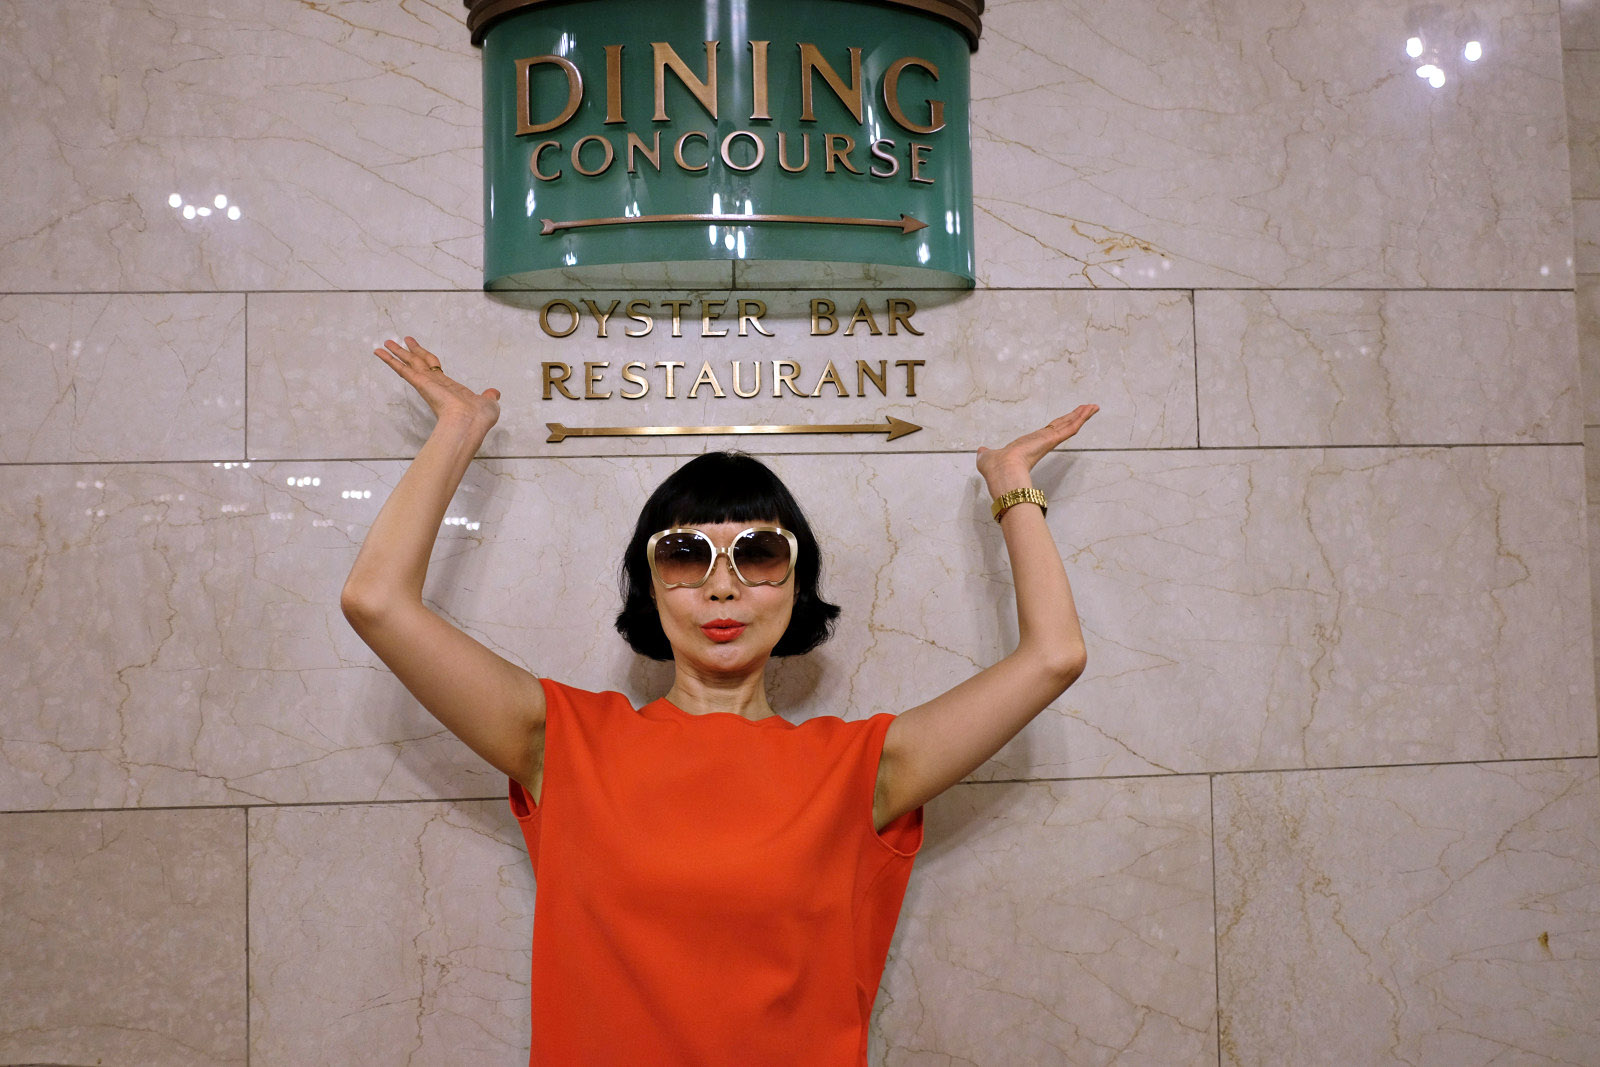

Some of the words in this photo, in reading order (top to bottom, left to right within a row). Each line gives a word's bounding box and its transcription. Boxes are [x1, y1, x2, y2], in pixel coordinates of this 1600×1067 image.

[514, 40, 947, 137] DINING
[530, 130, 935, 184] CONCOURSE
[539, 298, 775, 338] OYSTER
[810, 298, 925, 336] BAR
[541, 360, 926, 400] RESTAURANT
